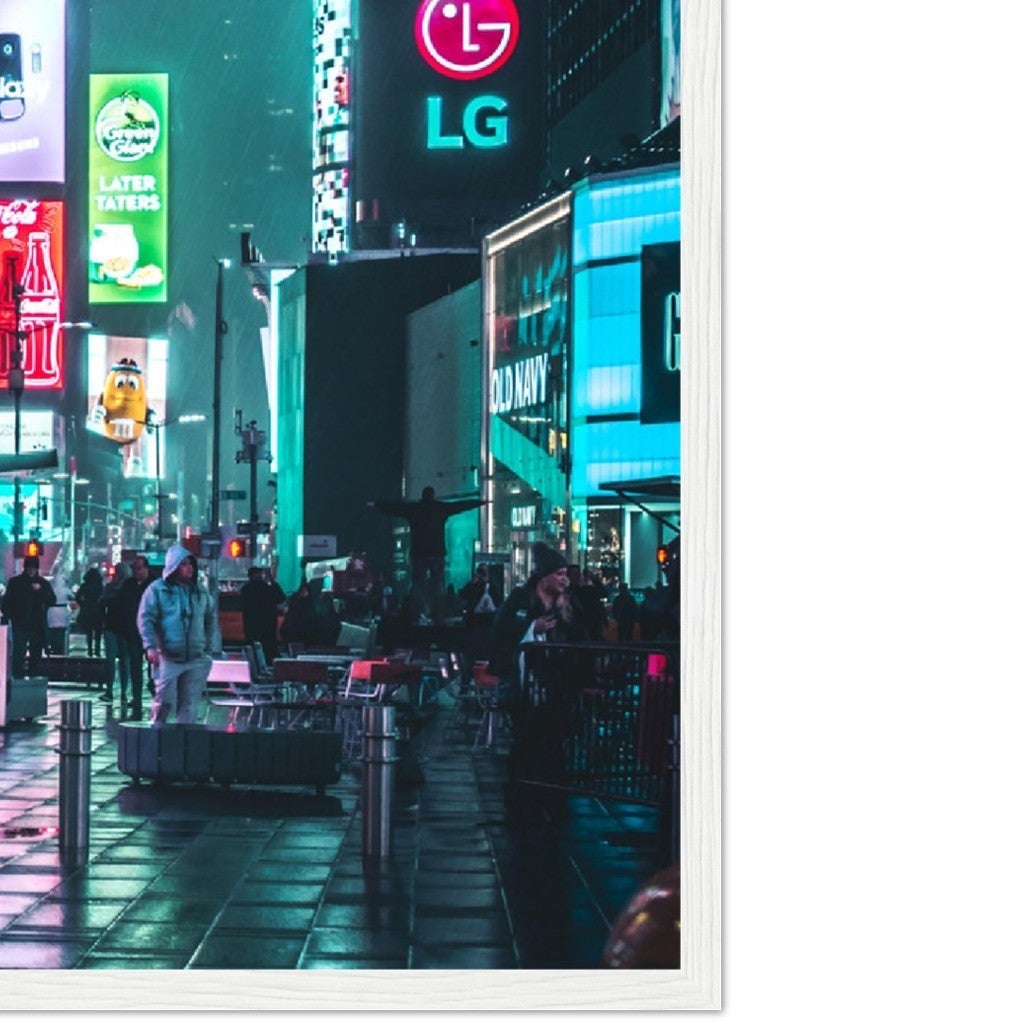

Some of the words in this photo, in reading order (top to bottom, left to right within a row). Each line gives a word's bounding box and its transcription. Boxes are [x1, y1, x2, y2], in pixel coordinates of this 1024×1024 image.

[427, 95, 509, 149] LG
[98, 174, 156, 192] LATER
[93, 194, 161, 212] TATERS
[490, 365, 513, 414] OLD
[514, 352, 549, 410] NAVY
